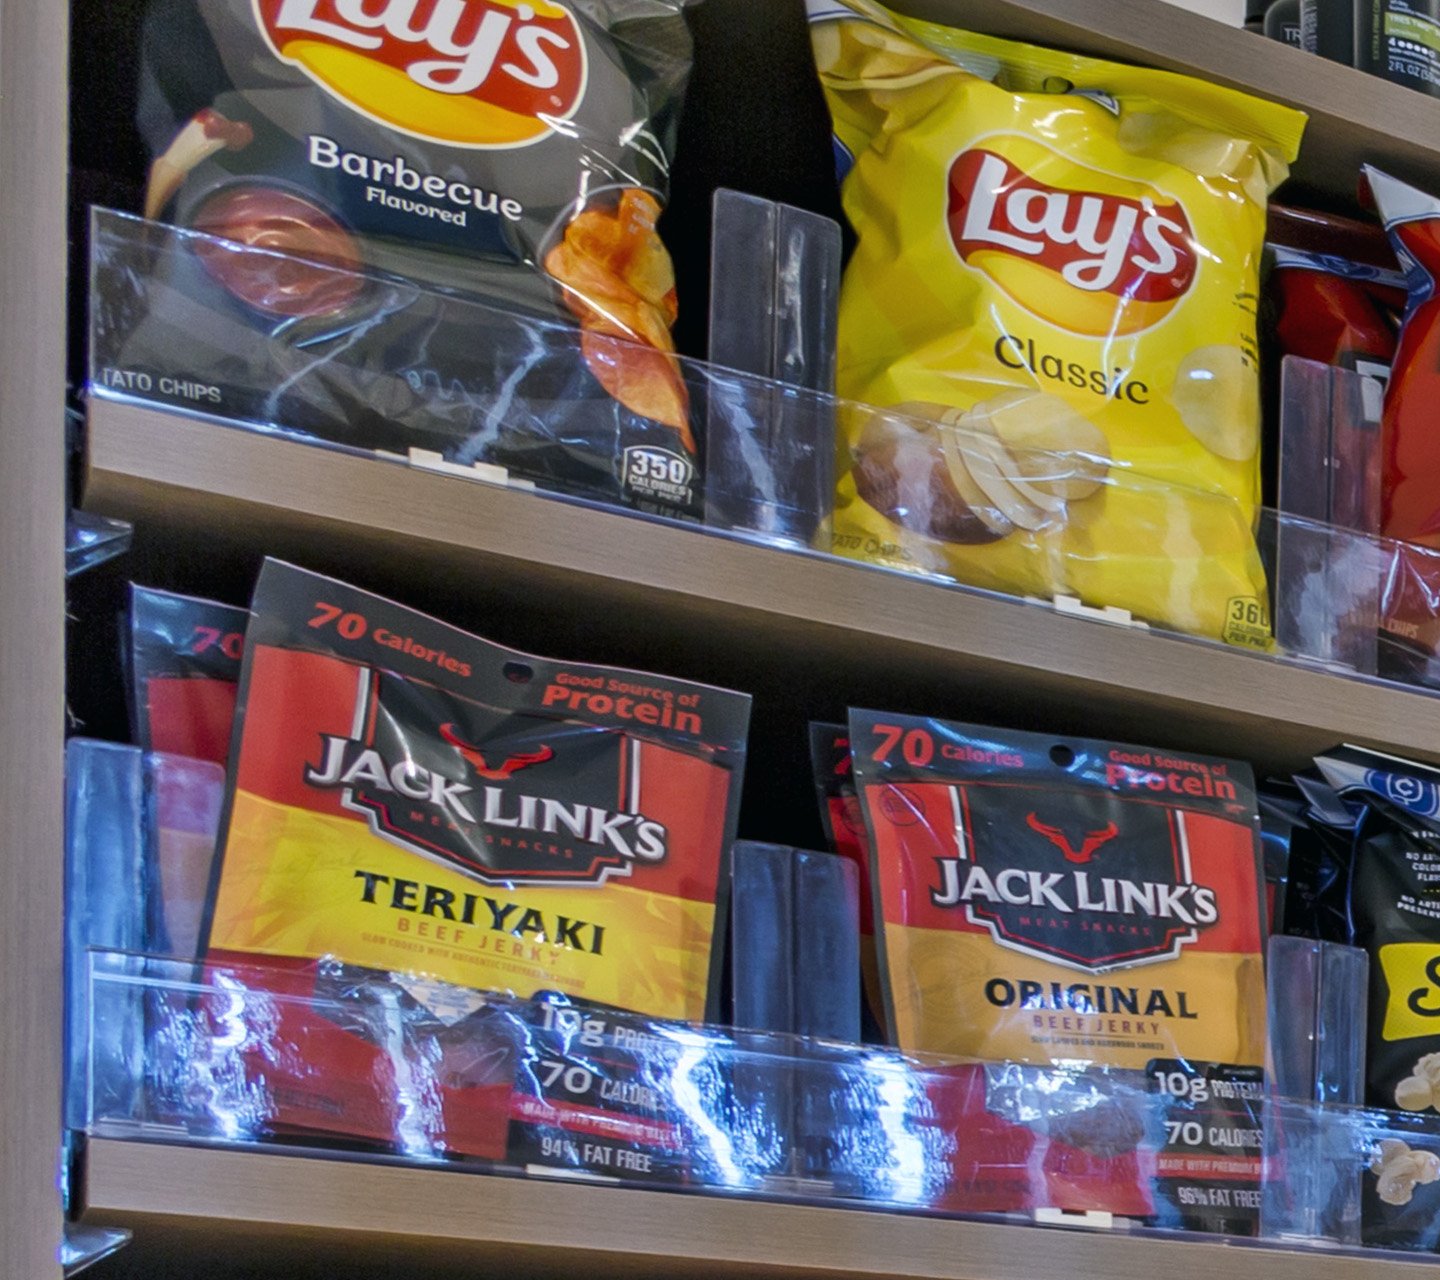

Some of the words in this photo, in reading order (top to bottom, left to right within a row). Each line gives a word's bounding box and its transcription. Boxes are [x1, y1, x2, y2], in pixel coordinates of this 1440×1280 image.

[308, 135, 524, 222] Barbecue
[366, 186, 468, 229] Flavored
[962, 153, 1183, 290] Lay's
[994, 335, 1149, 406] Classic
[631, 450, 686, 487] 350
[307, 602, 367, 640] 70
[373, 627, 472, 678] Calories
[543, 685, 701, 733] Protein
[555, 672, 604, 689] Good
[608, 678, 674, 701] Source
[678, 691, 700, 706] of
[871, 724, 934, 766] 70
[941, 744, 1024, 769] Calories
[308, 734, 473, 810] JACK
[484, 785, 666, 861] LINK'S
[1107, 764, 1236, 799] Protein
[355, 870, 605, 956] TERIYAKI
[984, 977, 1198, 1021] ORIGINAL
